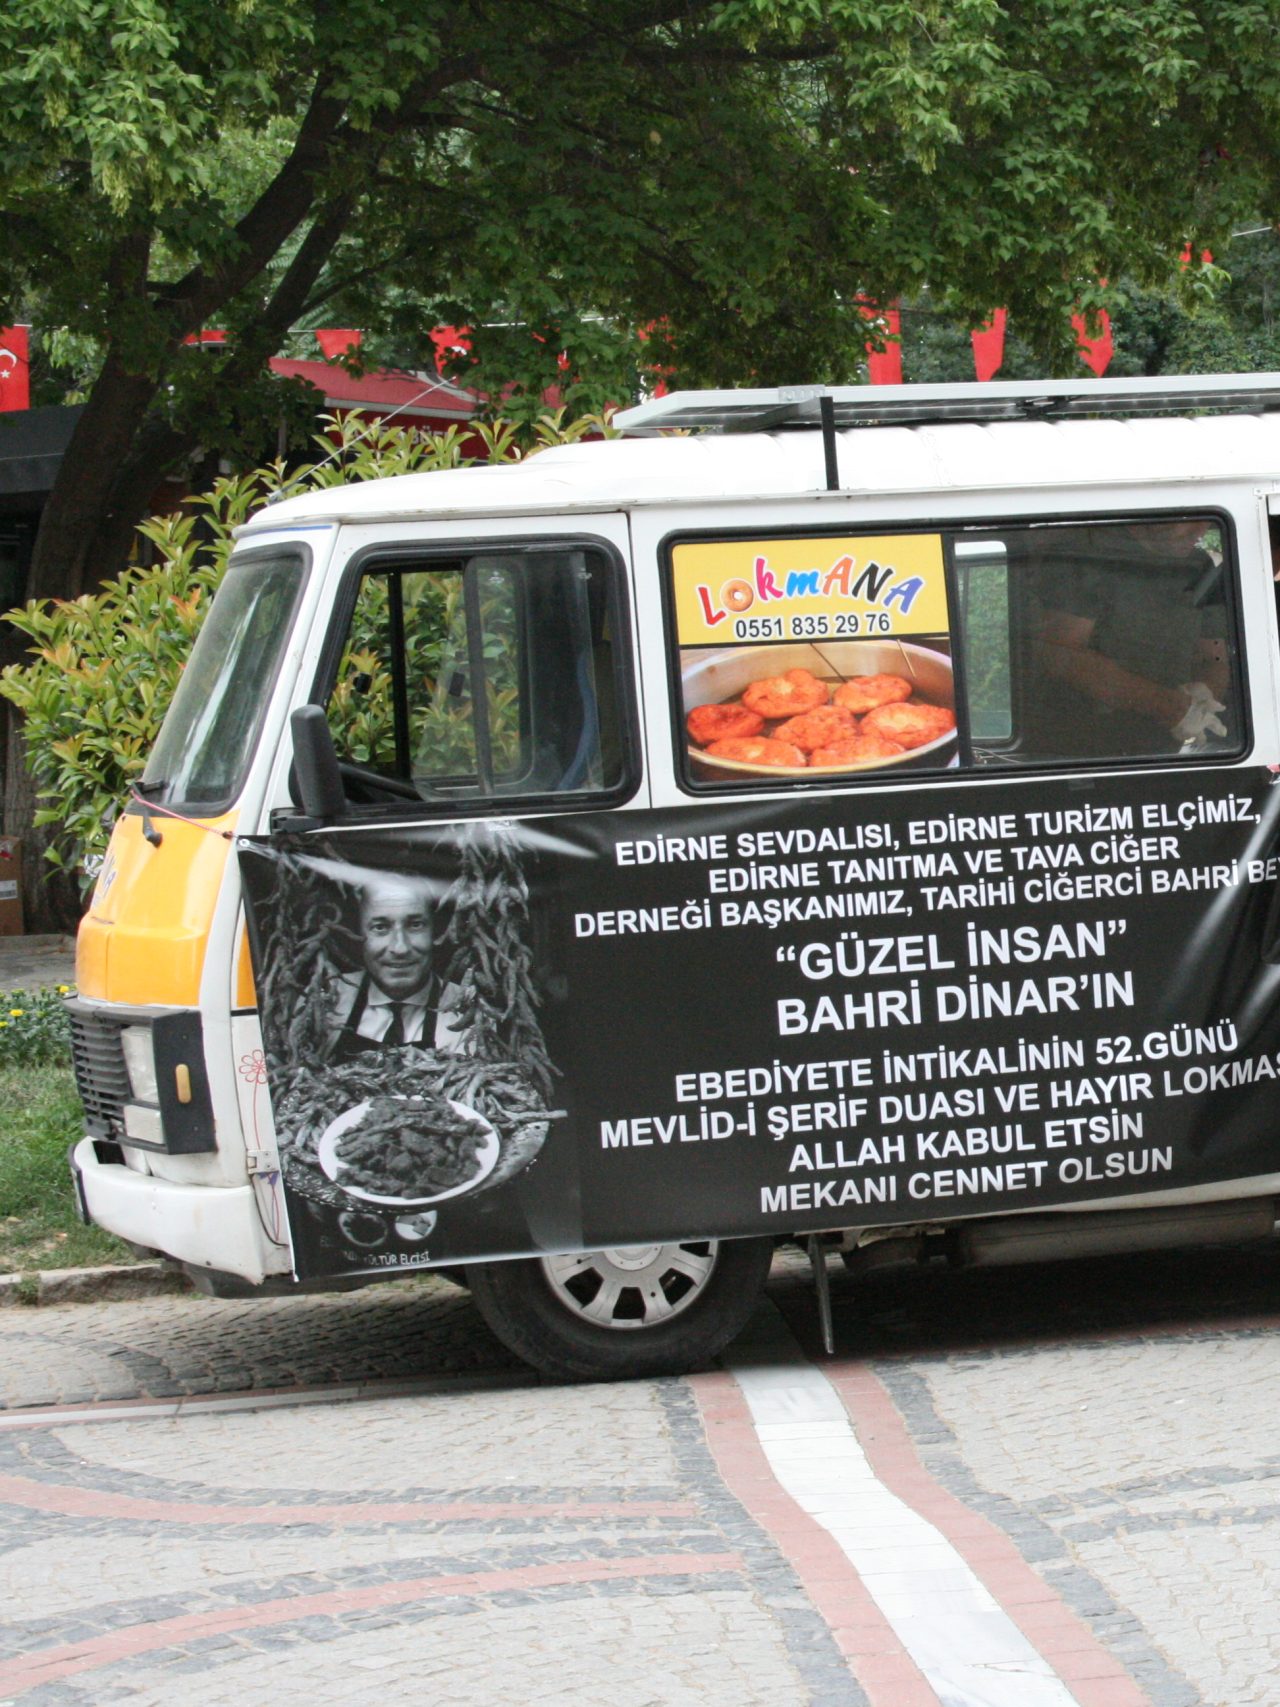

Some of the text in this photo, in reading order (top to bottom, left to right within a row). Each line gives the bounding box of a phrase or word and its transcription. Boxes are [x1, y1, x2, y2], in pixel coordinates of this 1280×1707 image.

[736, 613, 890, 638] 0551 835 29 76
[615, 793, 1262, 865] EDİRNE SEVDALISI, EDİRNE TURİZM ELÇİMİZ,
[709, 835, 1180, 893] EDİRNE TANITMA VE TAVA CİĞER
[574, 900, 711, 937] DERNEĞİ
[720, 890, 913, 928] BAŞKANIMIZ,
[920, 877, 1015, 911] TARİHİ
[1024, 866, 1143, 902] CİĞERCİ
[1151, 859, 1239, 893] BAHRİ
[777, 980, 921, 1035] BAHRİ
[675, 1059, 873, 1102] EBEDİYETE
[883, 1034, 1084, 1084] İNTİKALİNİN
[767, 1094, 867, 1140] ŞERİF
[879, 1087, 985, 1125] DUASI
[994, 1083, 1039, 1112] VE
[1051, 1073, 1153, 1108] HAYIR
[788, 1108, 1143, 1172] ALLAH KABUL ETSİN
[760, 1146, 1173, 1213] MEKANI CENNET OLSUN
